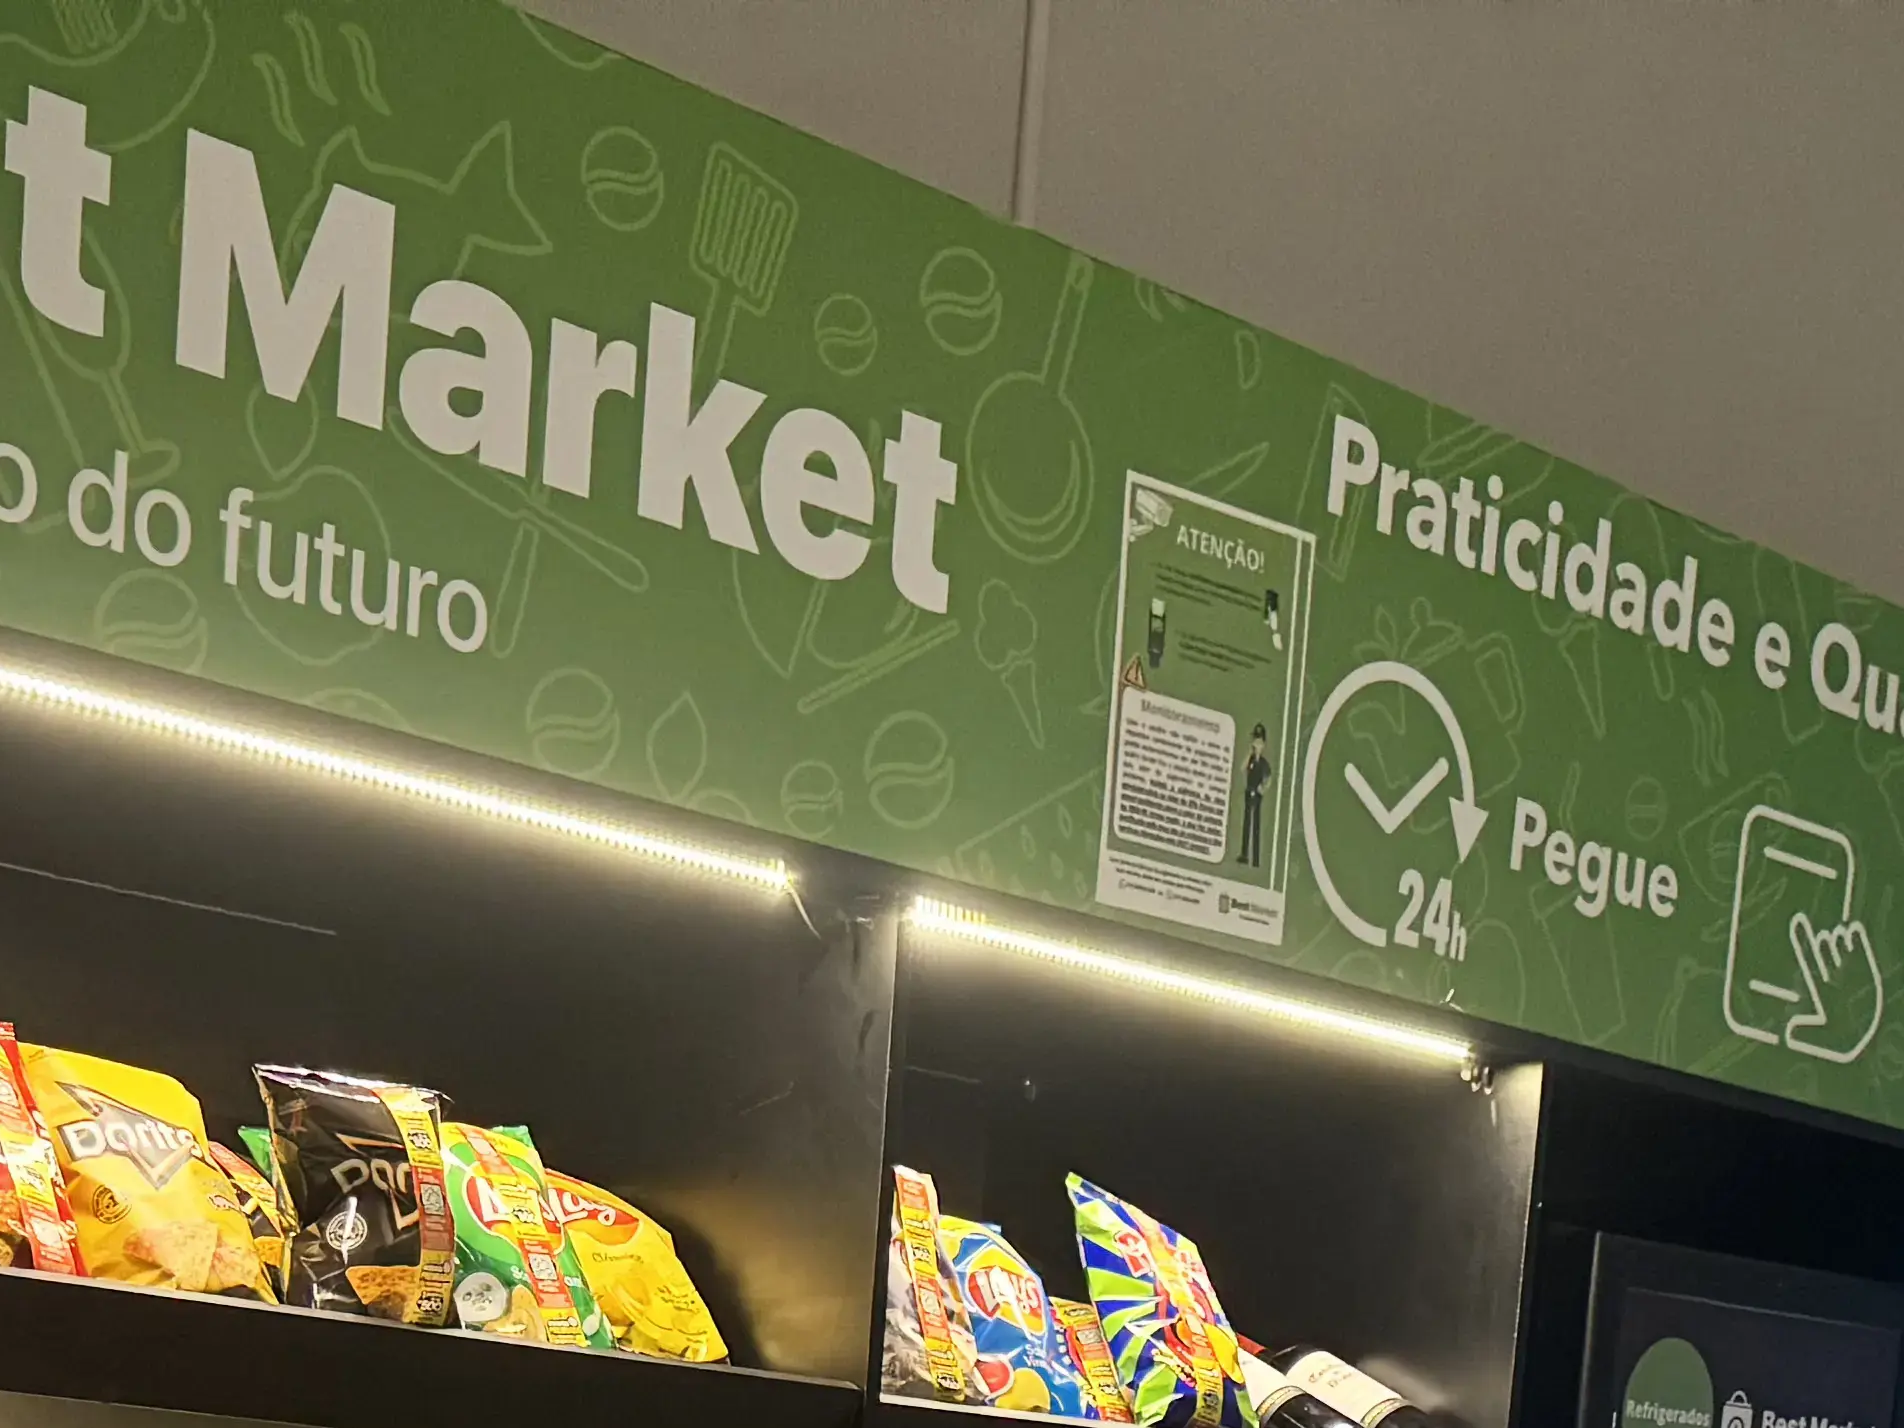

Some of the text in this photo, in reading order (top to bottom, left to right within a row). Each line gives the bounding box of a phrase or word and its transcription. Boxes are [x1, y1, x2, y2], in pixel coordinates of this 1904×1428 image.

[172, 127, 959, 618] Market
[65, 445, 195, 576] do
[216, 487, 493, 660] futuro
[1176, 523, 1266, 574] ATENÇÃO!
[1325, 412, 1737, 670] Praticidade
[1754, 614, 1793, 692] e
[1393, 866, 1469, 965] 24h
[1509, 795, 1681, 920] Pegue
[1626, 1399, 1710, 1426] Refrigerados
